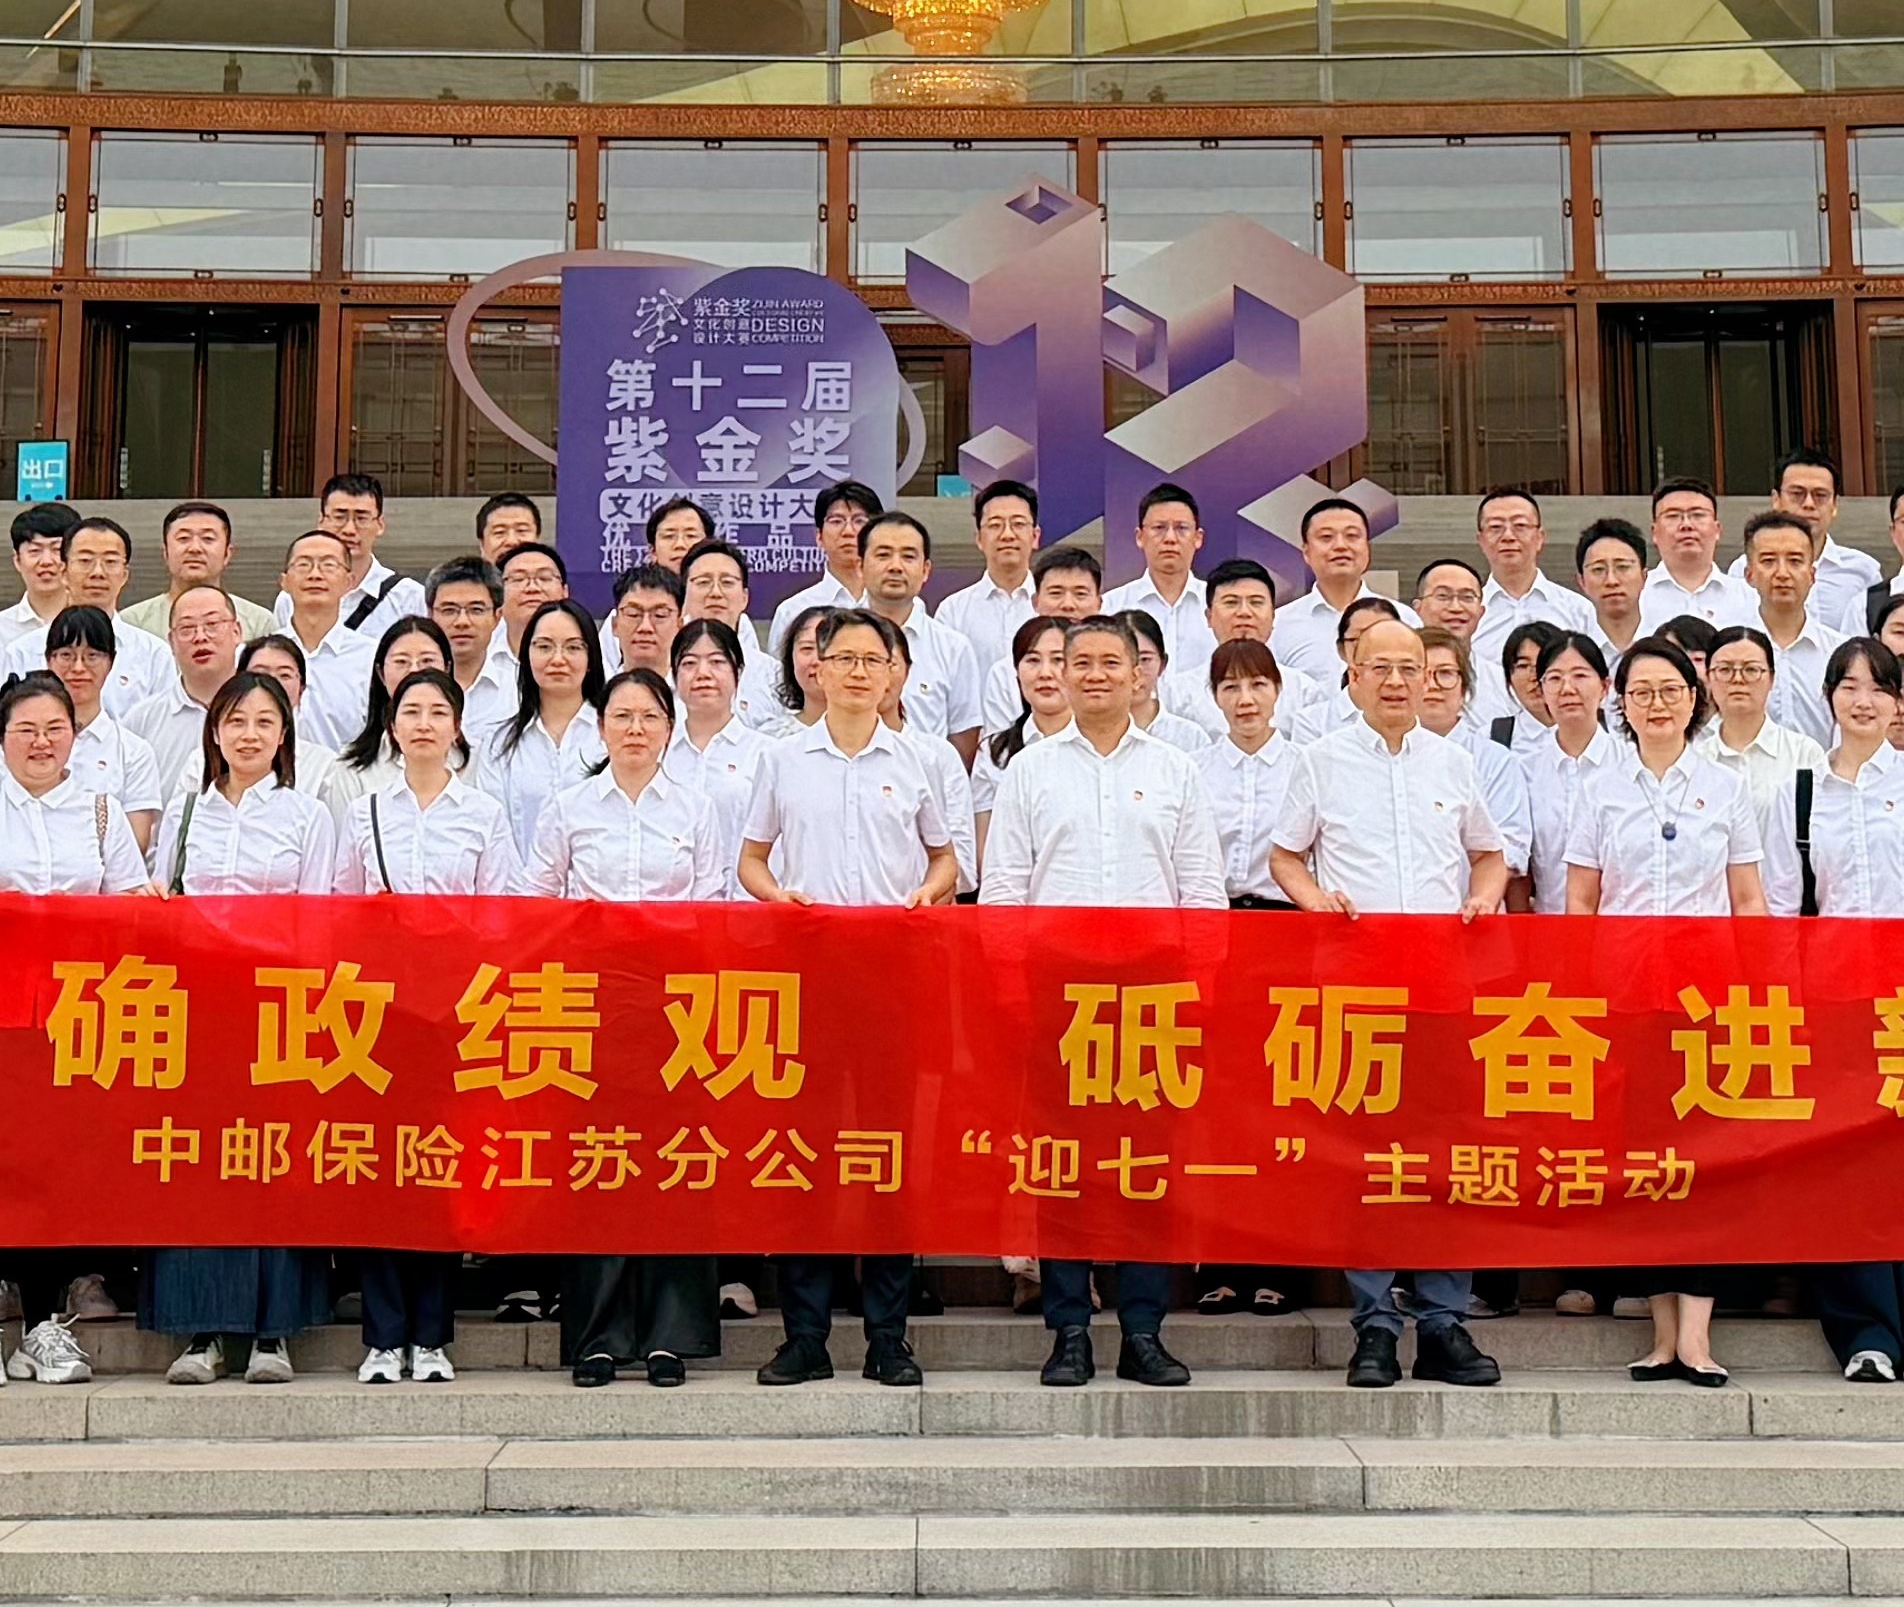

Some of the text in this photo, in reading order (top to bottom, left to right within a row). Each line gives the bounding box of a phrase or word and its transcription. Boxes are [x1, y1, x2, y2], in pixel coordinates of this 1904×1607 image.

[693, 297, 750, 317] 紫金奖
[751, 317, 825, 333] DESIGN
[605, 358, 852, 412] 第十二届
[604, 416, 853, 484] 紫金奖
[22, 458, 64, 480] 出口
[607, 492, 814, 519] 文化意设计大
